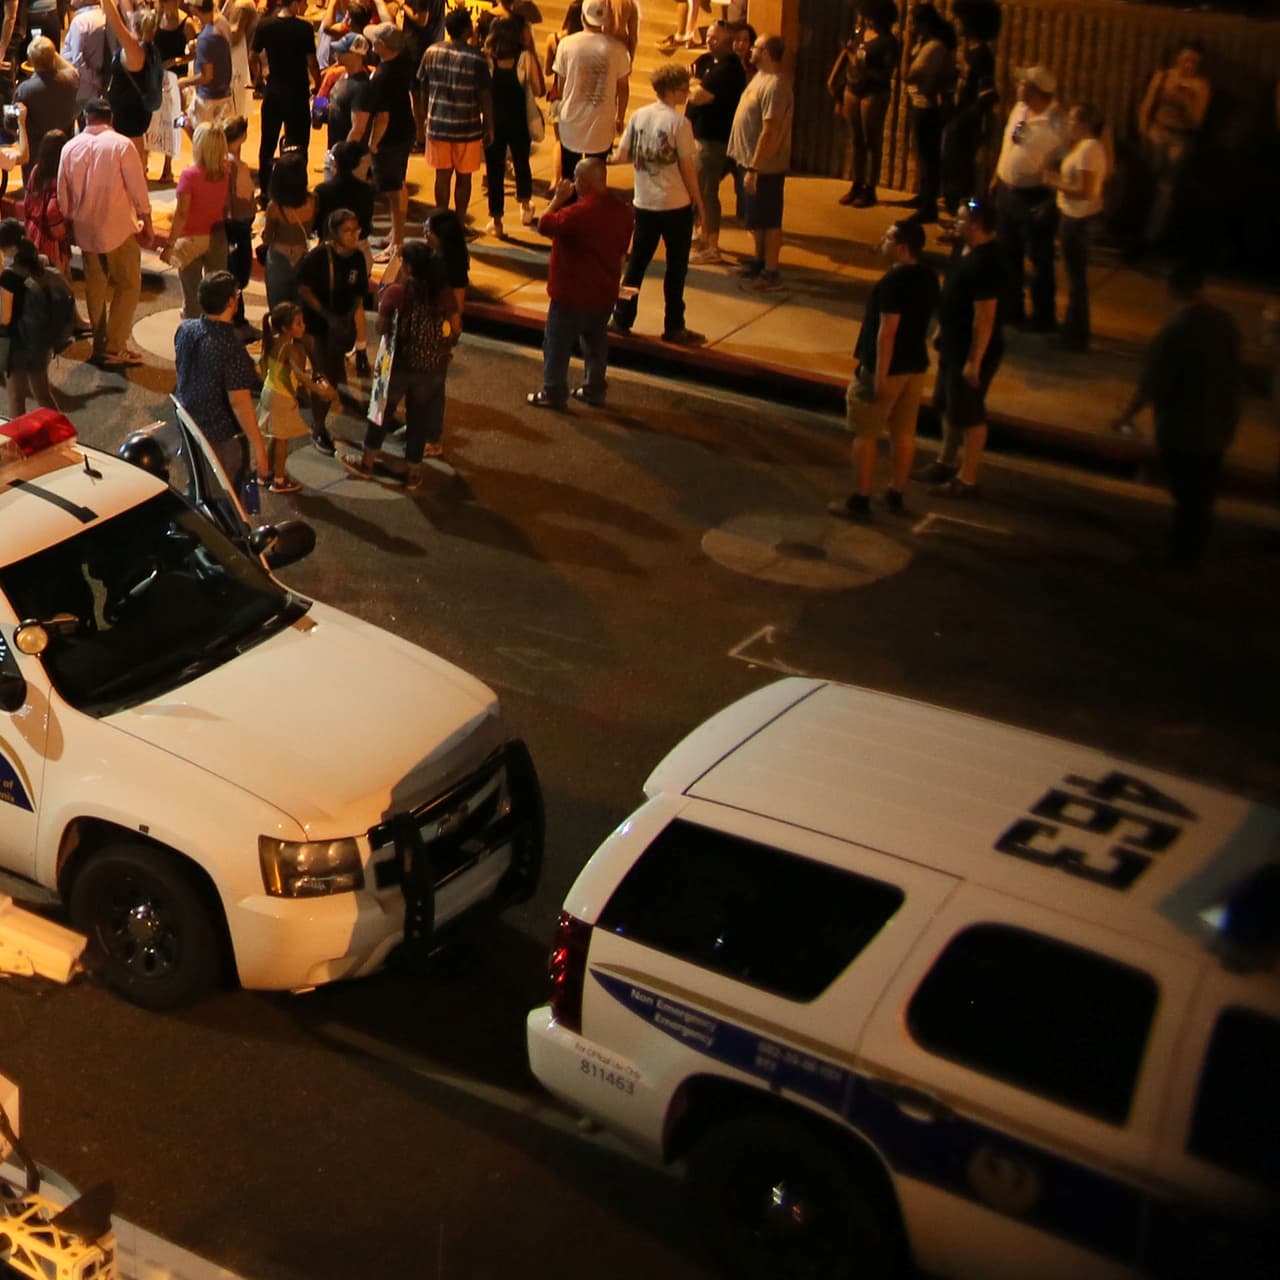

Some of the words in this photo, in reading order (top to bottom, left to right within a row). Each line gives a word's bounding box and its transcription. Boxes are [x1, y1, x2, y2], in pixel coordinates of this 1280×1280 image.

[2, 779, 15, 790] of
[630, 988, 654, 1007] Non
[655, 996, 718, 1033] Emergency
[654, 1012, 716, 1049] Emergency
[579, 1059, 636, 1096] 811463
